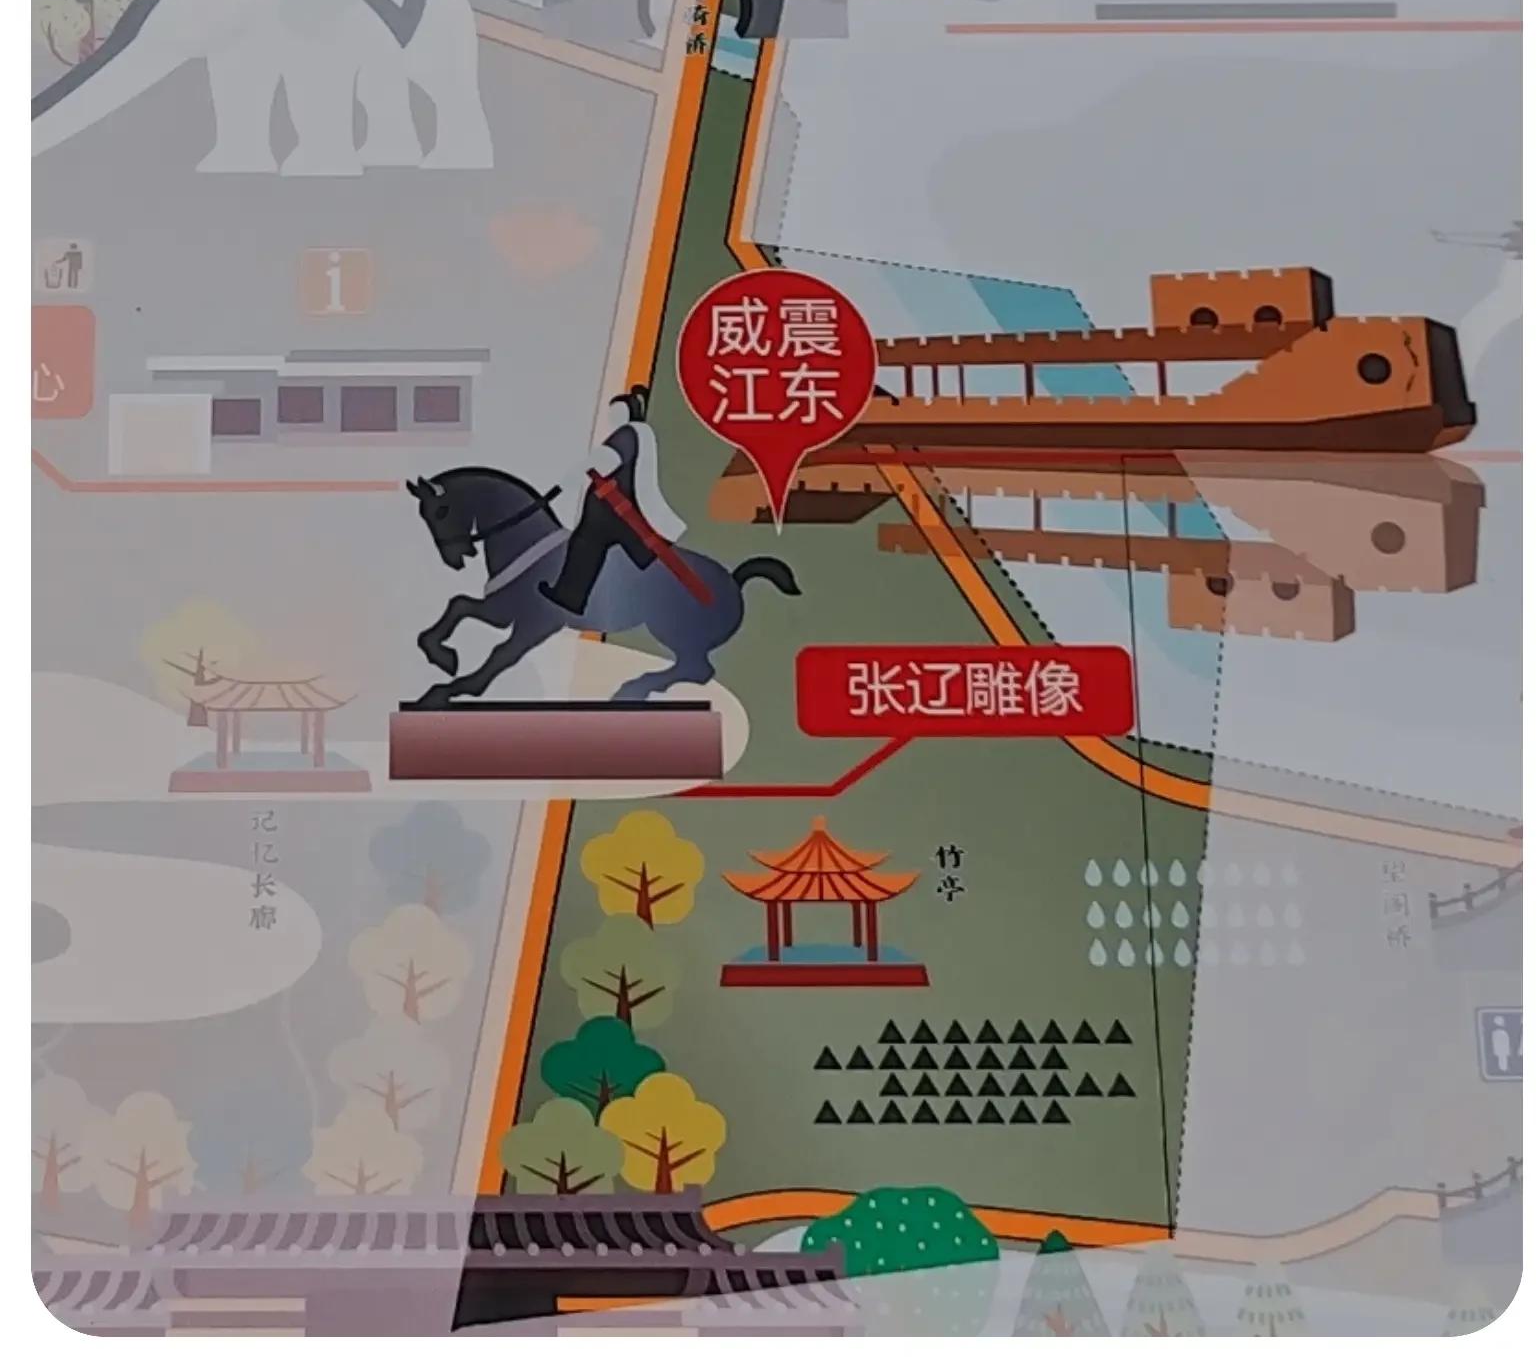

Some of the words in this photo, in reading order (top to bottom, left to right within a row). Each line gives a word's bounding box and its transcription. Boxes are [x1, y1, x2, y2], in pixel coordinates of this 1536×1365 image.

[707, 296, 842, 357] 威震
[709, 362, 844, 424] 江东
[848, 660, 1083, 717] 张辽雕像
[250, 810, 279, 930] 记忆长廊
[935, 844, 965, 902] 竹亭
